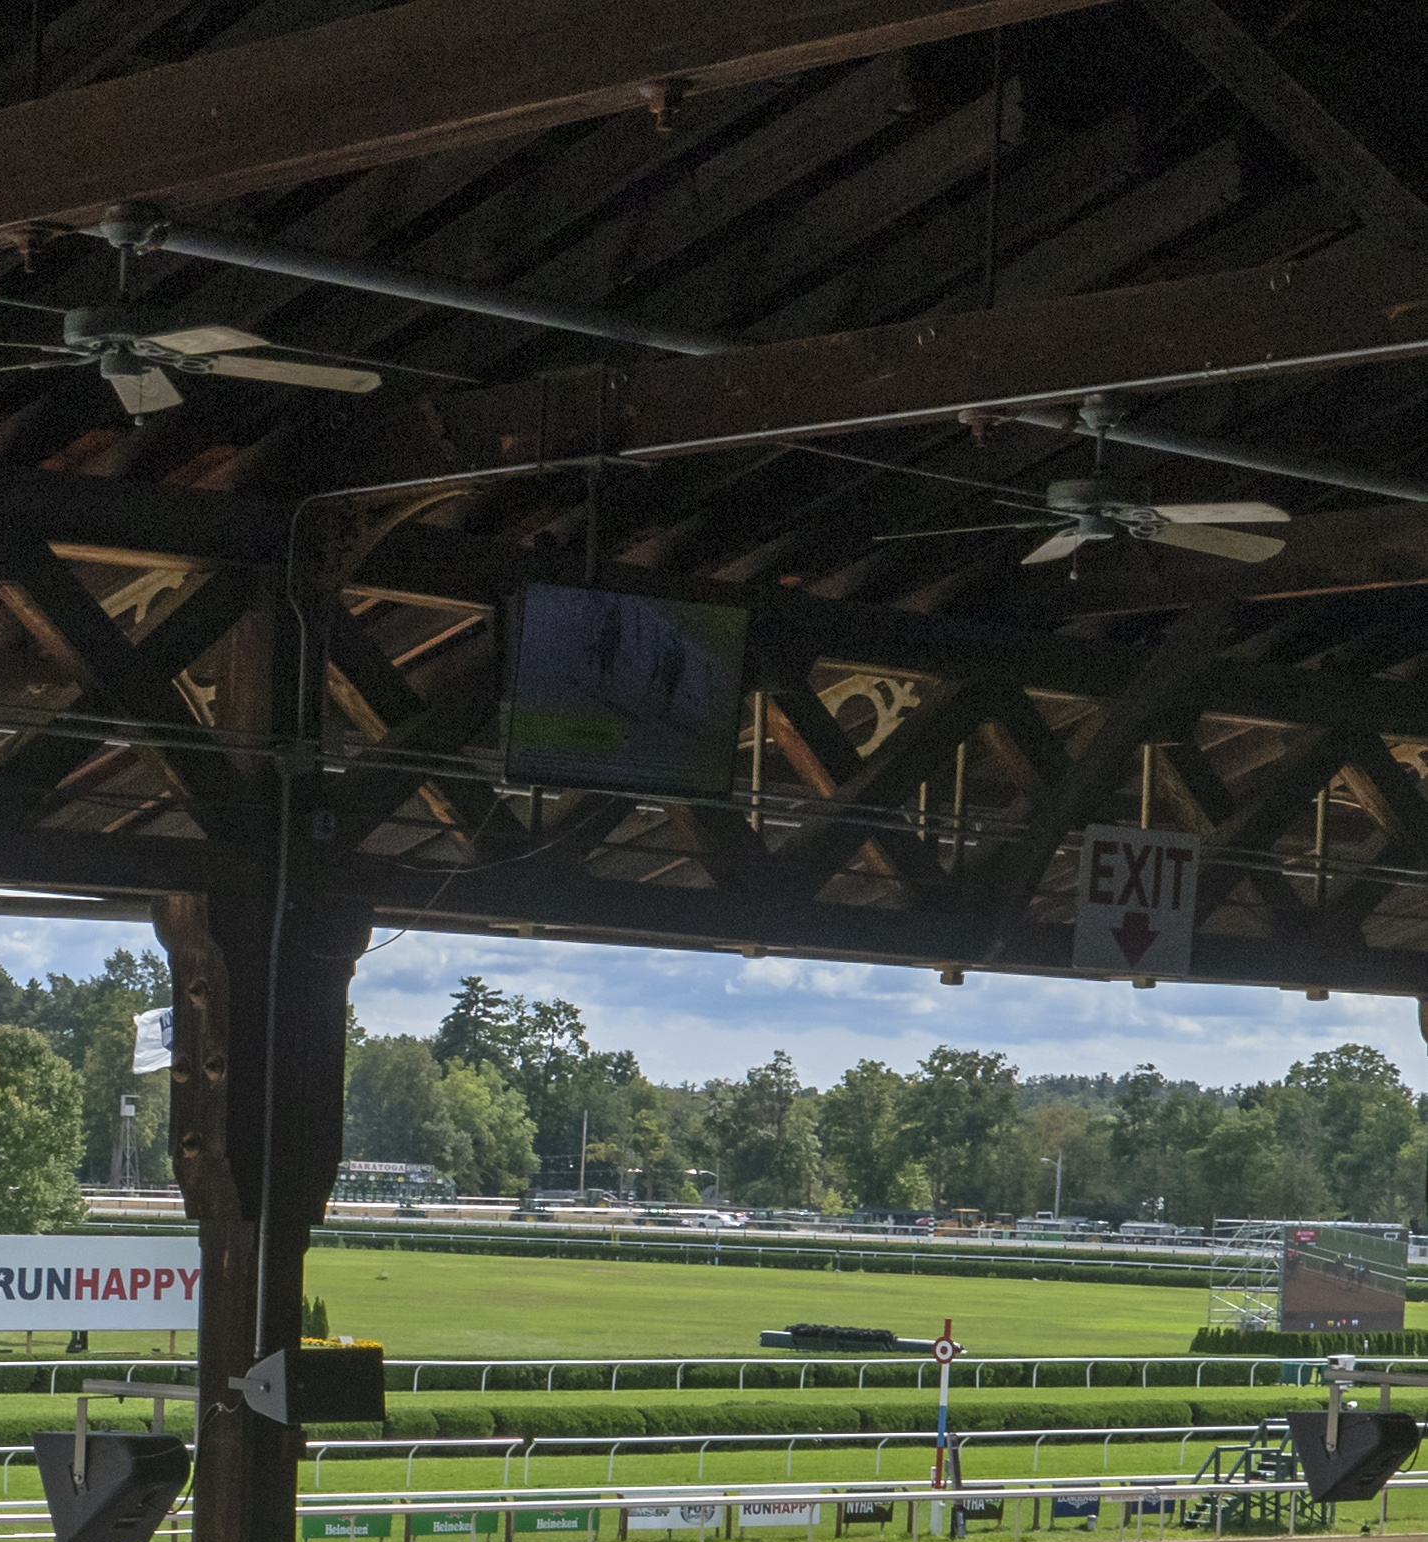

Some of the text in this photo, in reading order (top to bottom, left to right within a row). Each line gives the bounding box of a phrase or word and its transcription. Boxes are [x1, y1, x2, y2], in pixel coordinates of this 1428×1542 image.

[1090, 841, 1192, 910] EXIT
[351, 1162, 405, 1171] SARATOGA
[536, 1518, 578, 1529] Heineken
